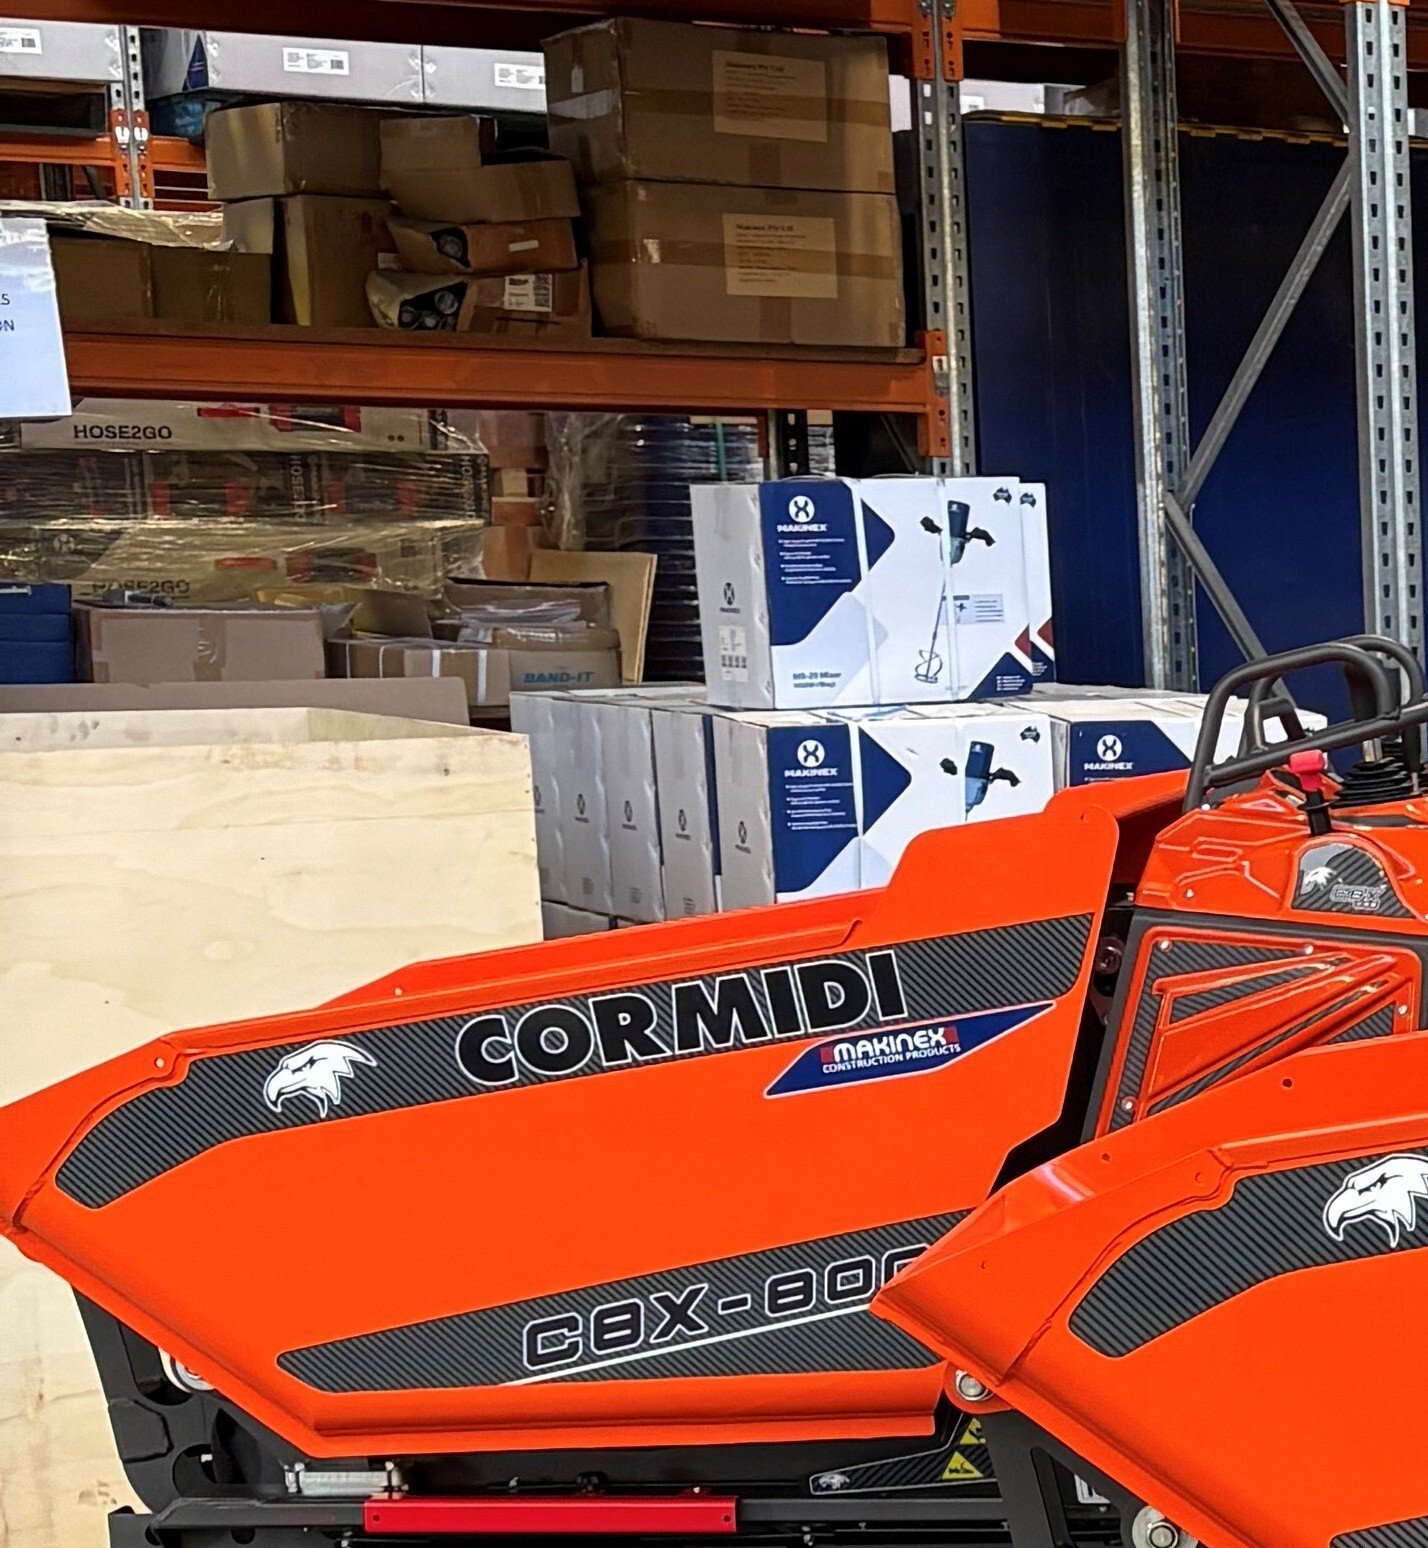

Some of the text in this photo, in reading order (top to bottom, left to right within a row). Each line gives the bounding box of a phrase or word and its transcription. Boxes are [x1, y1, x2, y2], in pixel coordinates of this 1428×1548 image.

[74, 424, 173, 440] HOSE2GO
[777, 523, 828, 532] MAKINEX
[524, 671, 594, 683] BAND-IT
[784, 768, 838, 777] MAKINEX
[1084, 762, 1133, 771] MAKINEX
[456, 950, 908, 1086] CORMIDI
[833, 1027, 947, 1064] MAKINEX
[822, 1044, 961, 1075] CONSTRUCTION PRODUCTS
